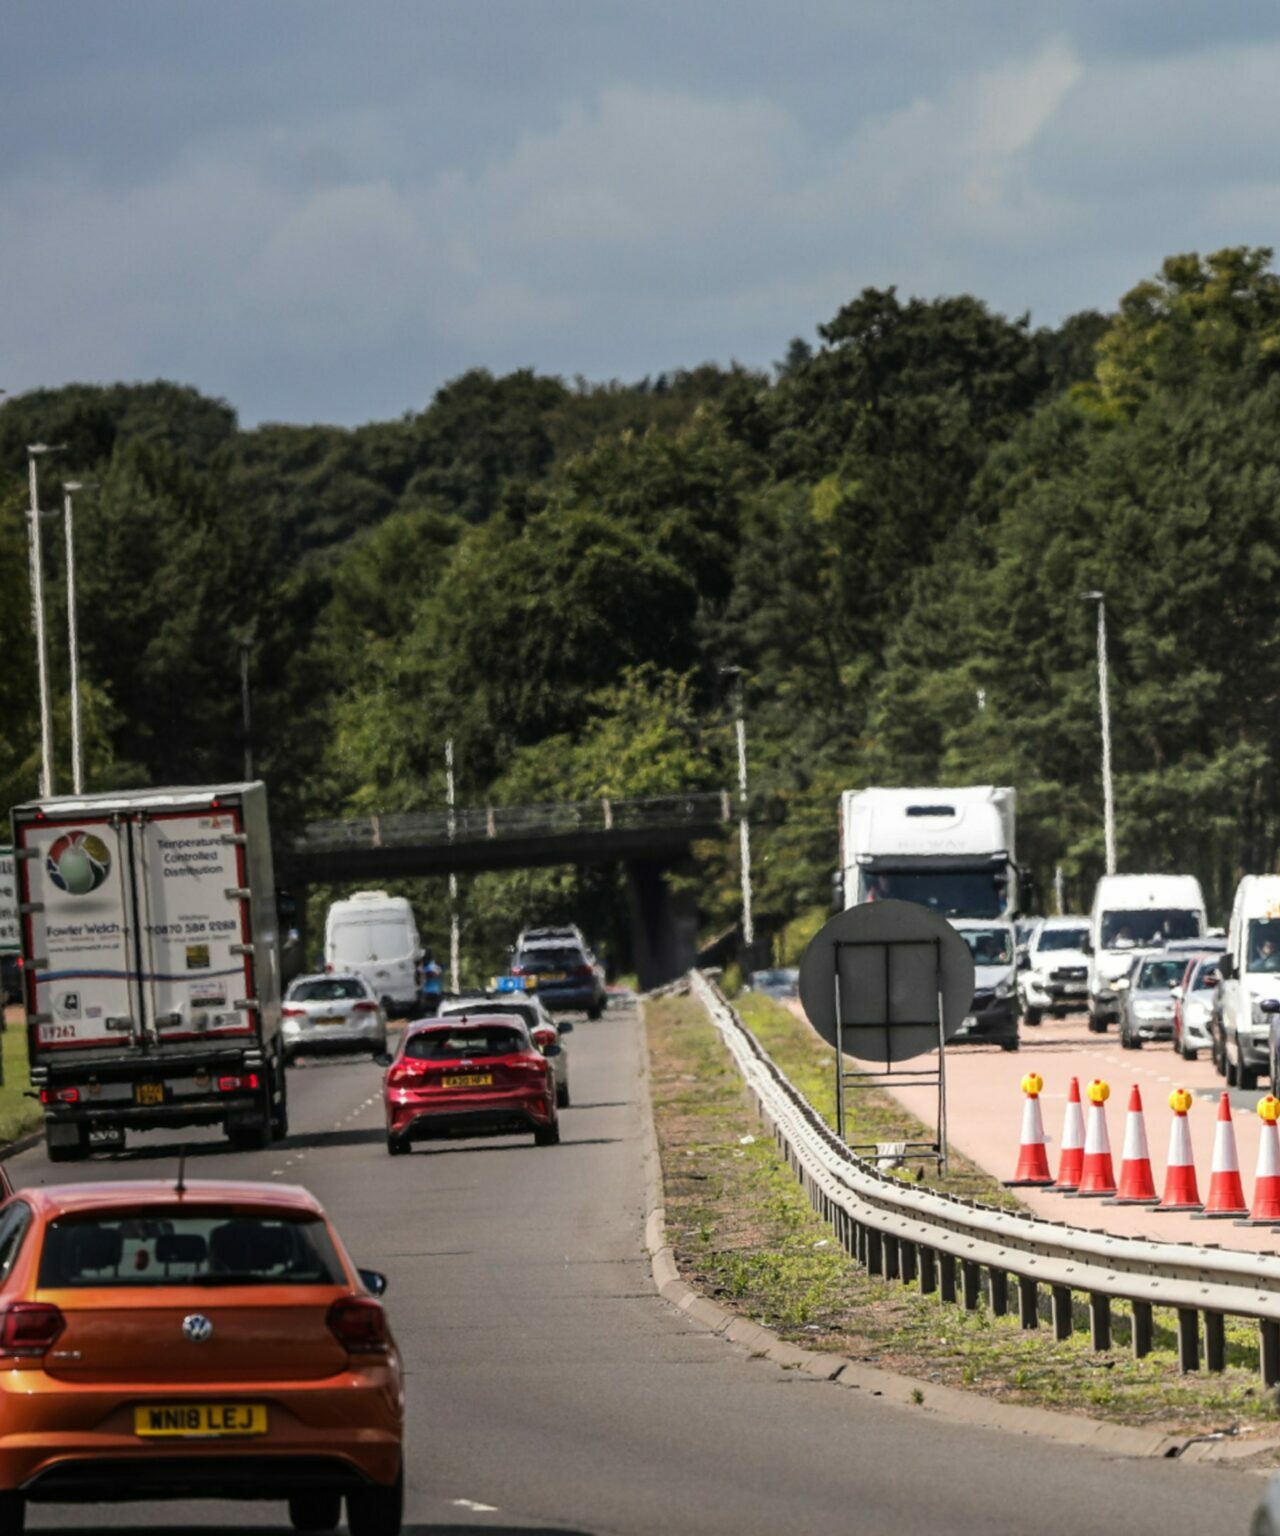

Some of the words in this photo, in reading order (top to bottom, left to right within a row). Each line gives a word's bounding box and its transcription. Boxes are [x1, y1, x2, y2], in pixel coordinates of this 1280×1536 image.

[164, 851, 217, 863] Controlled
[164, 865, 223, 877] Distribution
[46, 925, 82, 937] Fowler
[84, 922, 119, 935] Welch
[42, 1025, 75, 1040] 19262
[149, 1407, 200, 1430] WN18
[207, 1407, 253, 1430] LEJ
